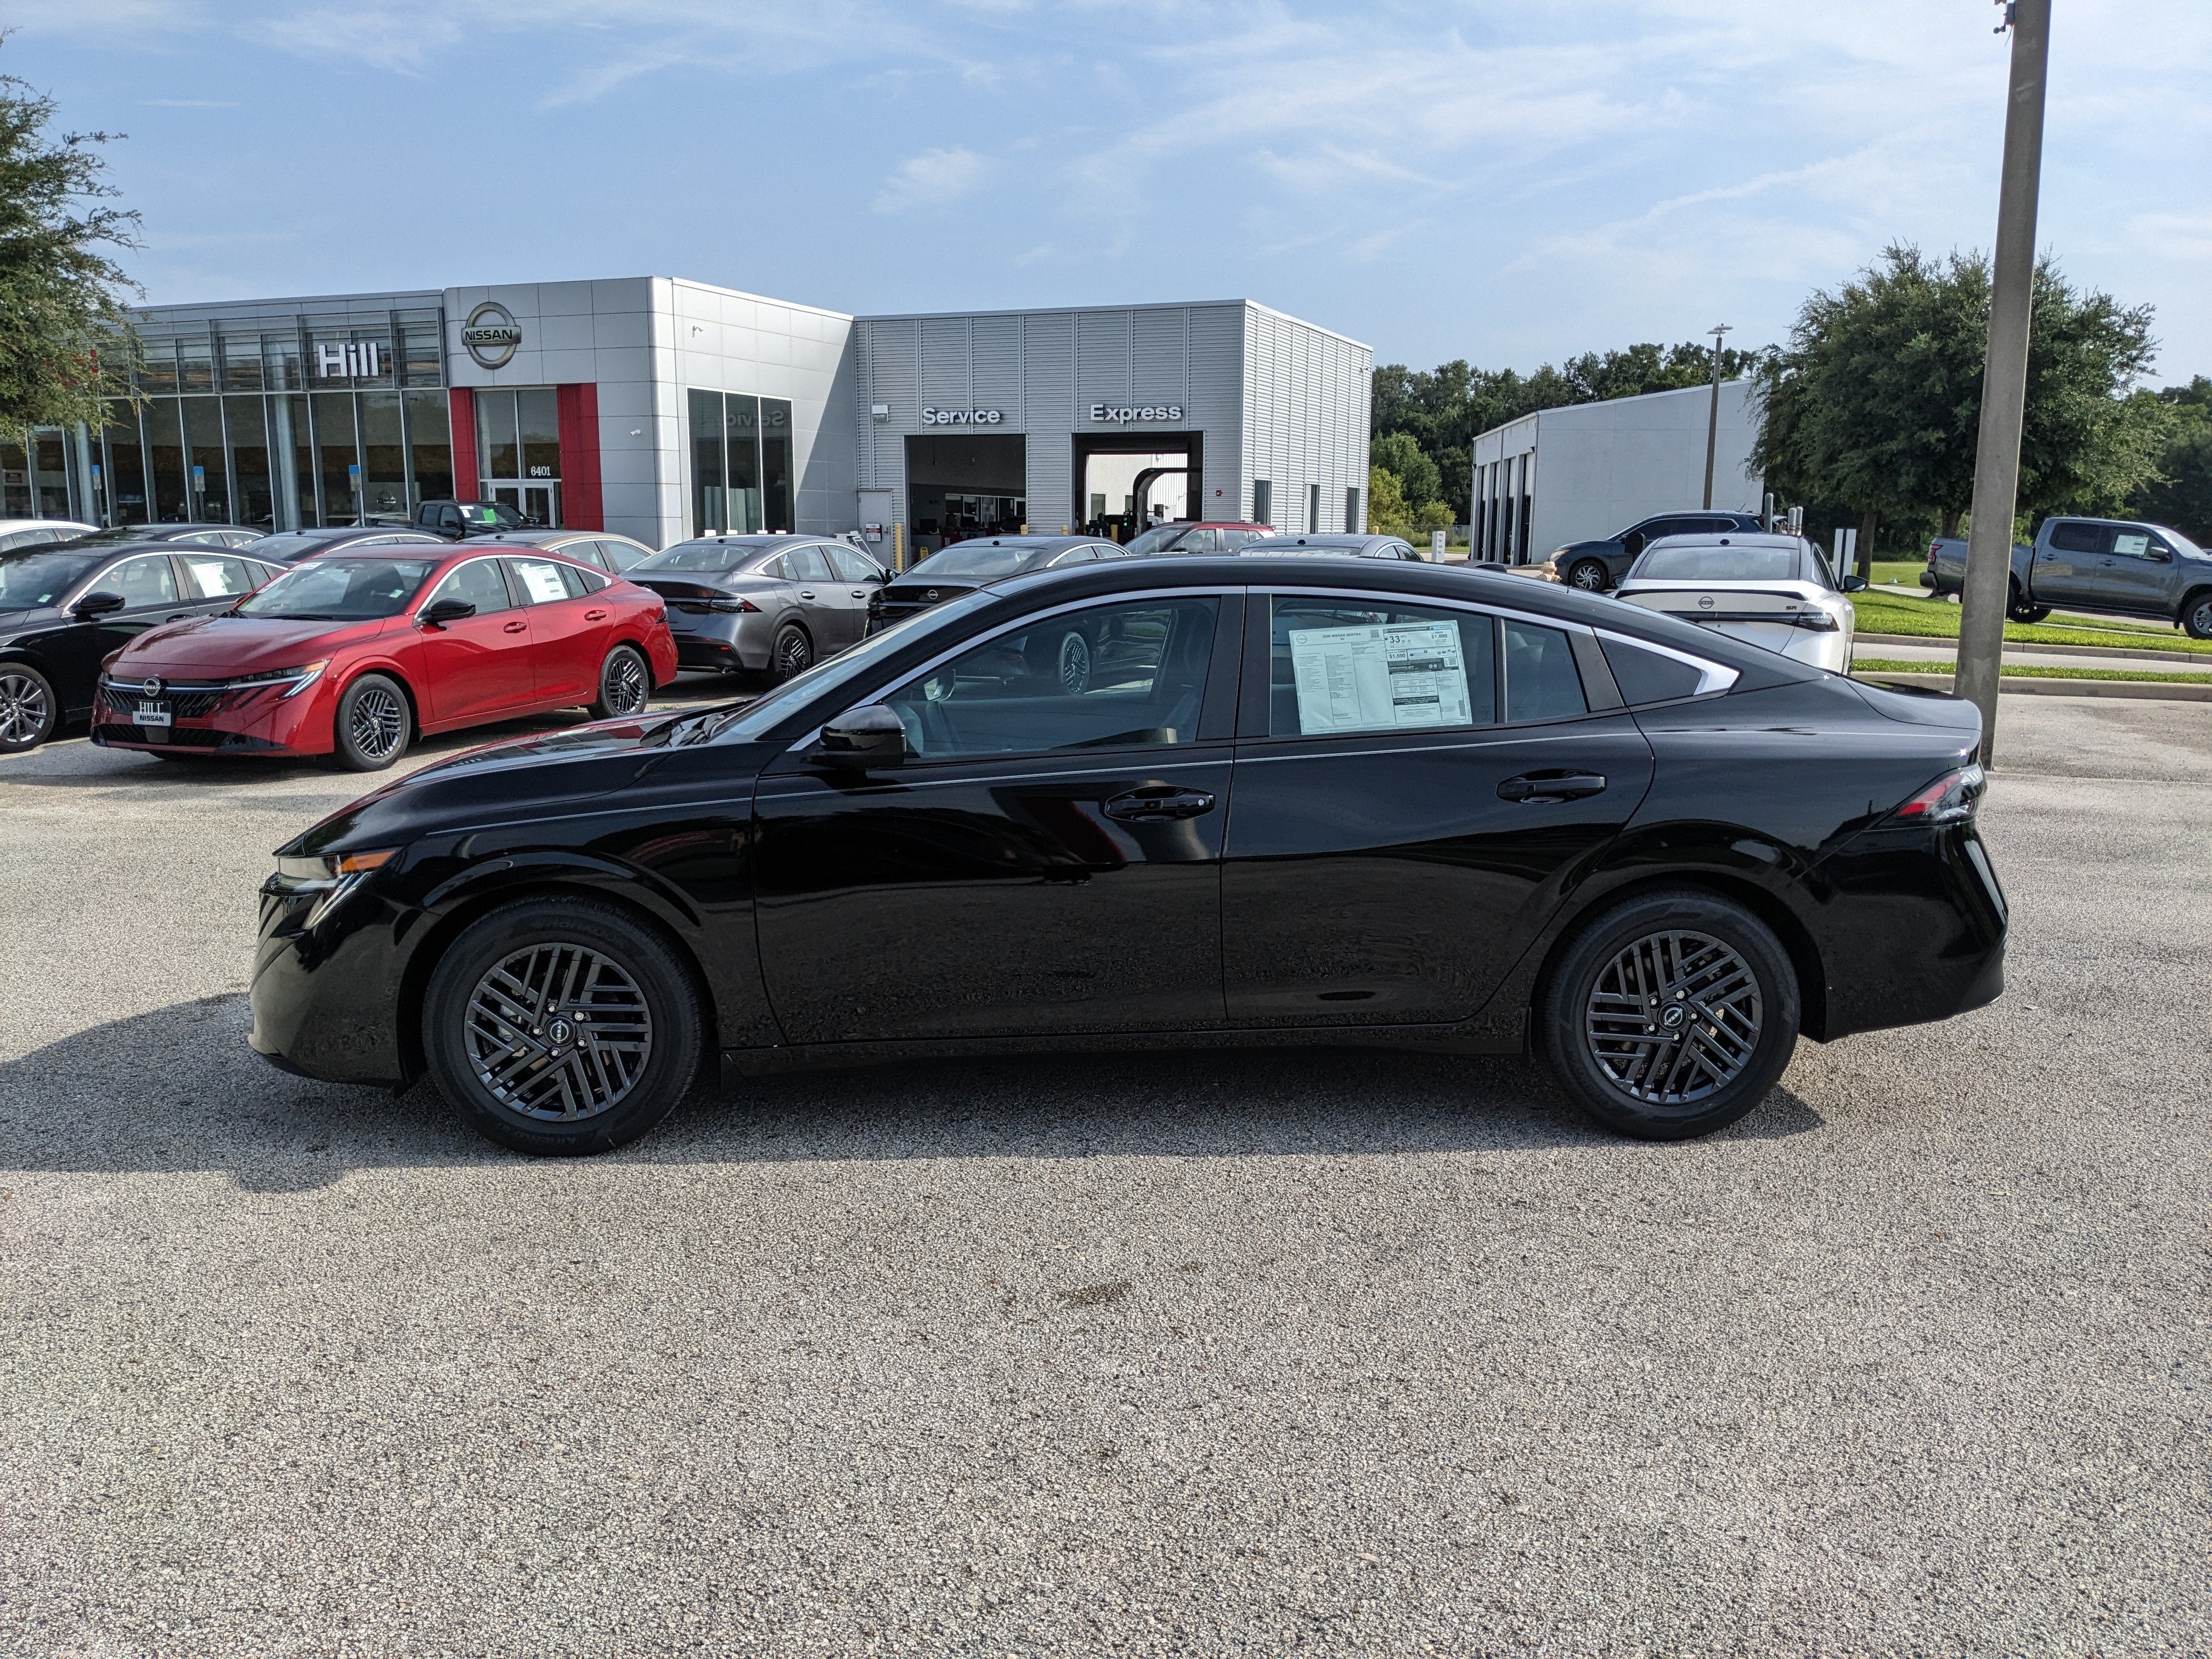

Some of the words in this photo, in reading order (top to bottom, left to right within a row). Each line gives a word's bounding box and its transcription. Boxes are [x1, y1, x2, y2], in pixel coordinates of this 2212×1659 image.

[465, 329, 512, 341] NISSAN
[319, 343, 379, 377] Hill
[922, 408, 1001, 424] Service
[1090, 404, 1182, 425] Express
[531, 466, 551, 476] 6401
[1389, 635, 1400, 644] 33
[140, 702, 164, 715] HILL
